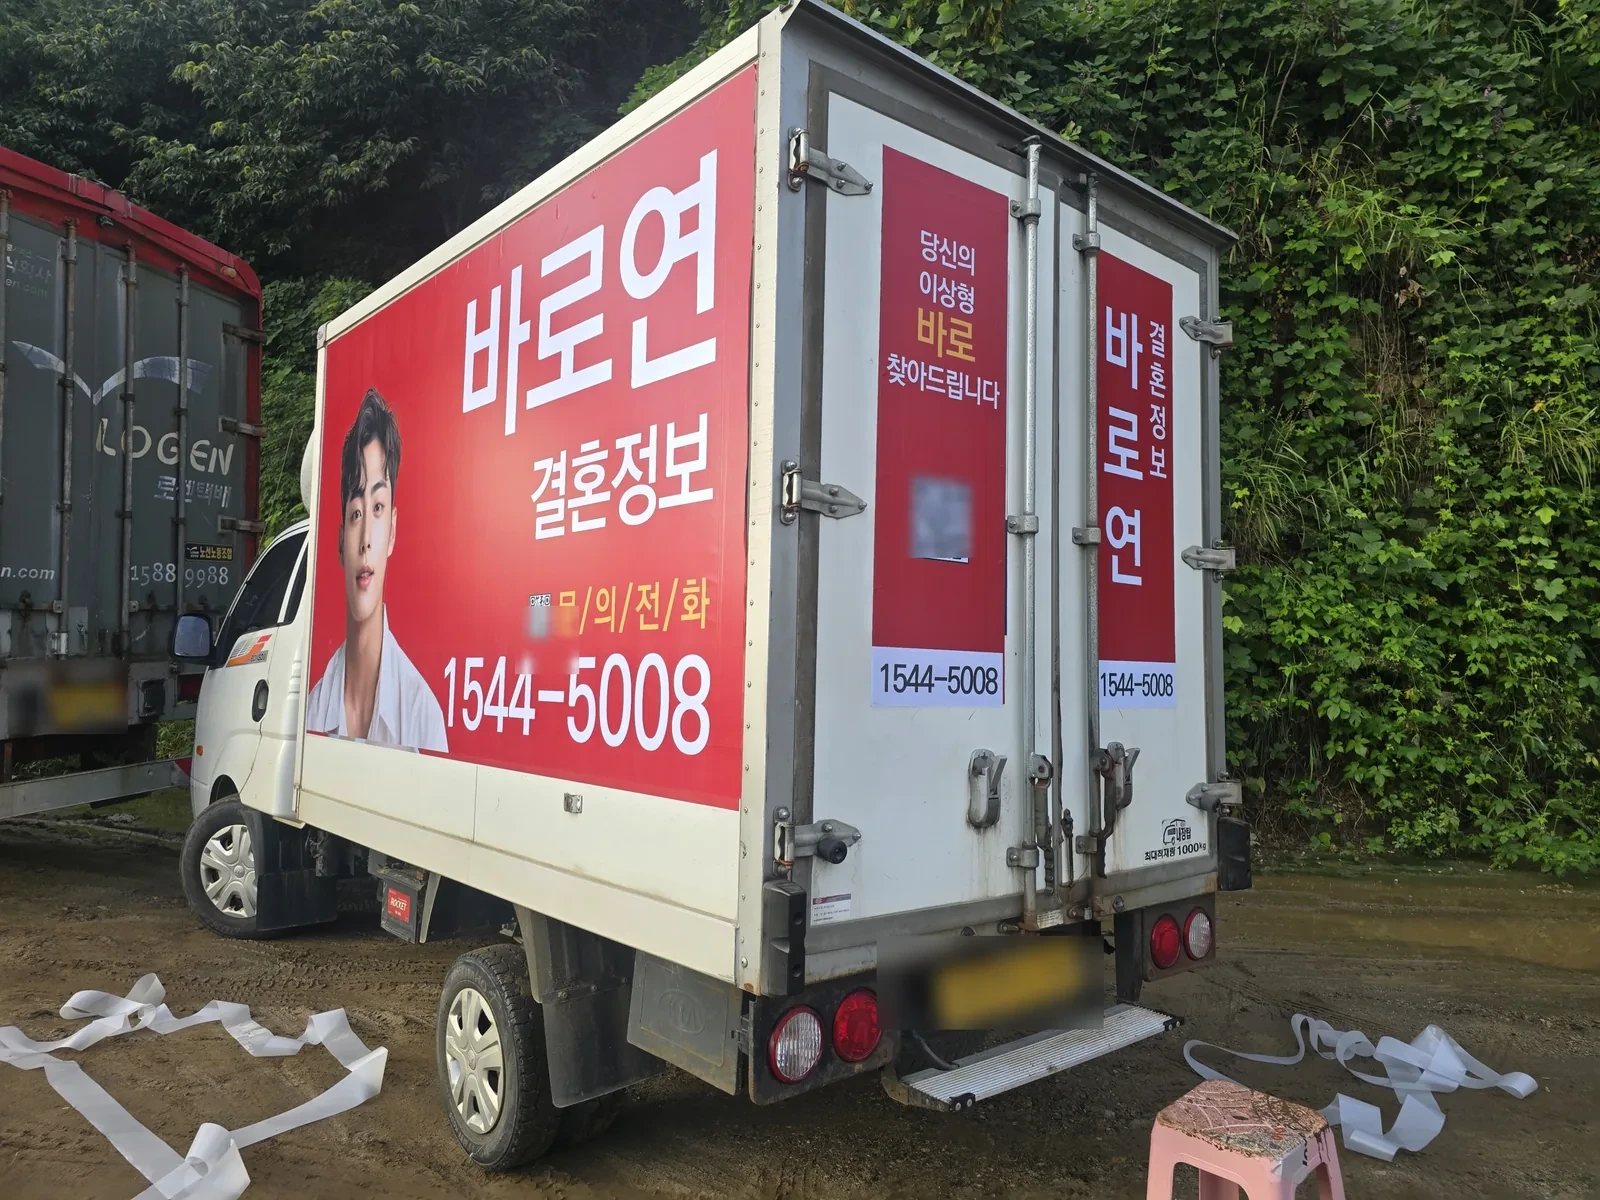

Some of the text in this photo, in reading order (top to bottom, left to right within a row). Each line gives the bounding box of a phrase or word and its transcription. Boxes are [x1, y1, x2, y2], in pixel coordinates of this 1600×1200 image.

[920, 229, 976, 277] 당신의
[462, 149, 718, 436] 바로연
[919, 271, 975, 315] 이상형
[917, 307, 976, 362] 바로
[886, 352, 1000, 410] 찾아드립니다
[1149, 320, 1167, 479] 결혼정보
[95, 418, 234, 476] LOGEN
[1103, 306, 1144, 586] 바로연
[530, 412, 714, 540] 결혼정보
[184, 565, 229, 588] 9988
[443, 653, 711, 756] 1544-5008
[879, 663, 999, 696] 1544-5008
[1100, 672, 1174, 697] 1544-5008
